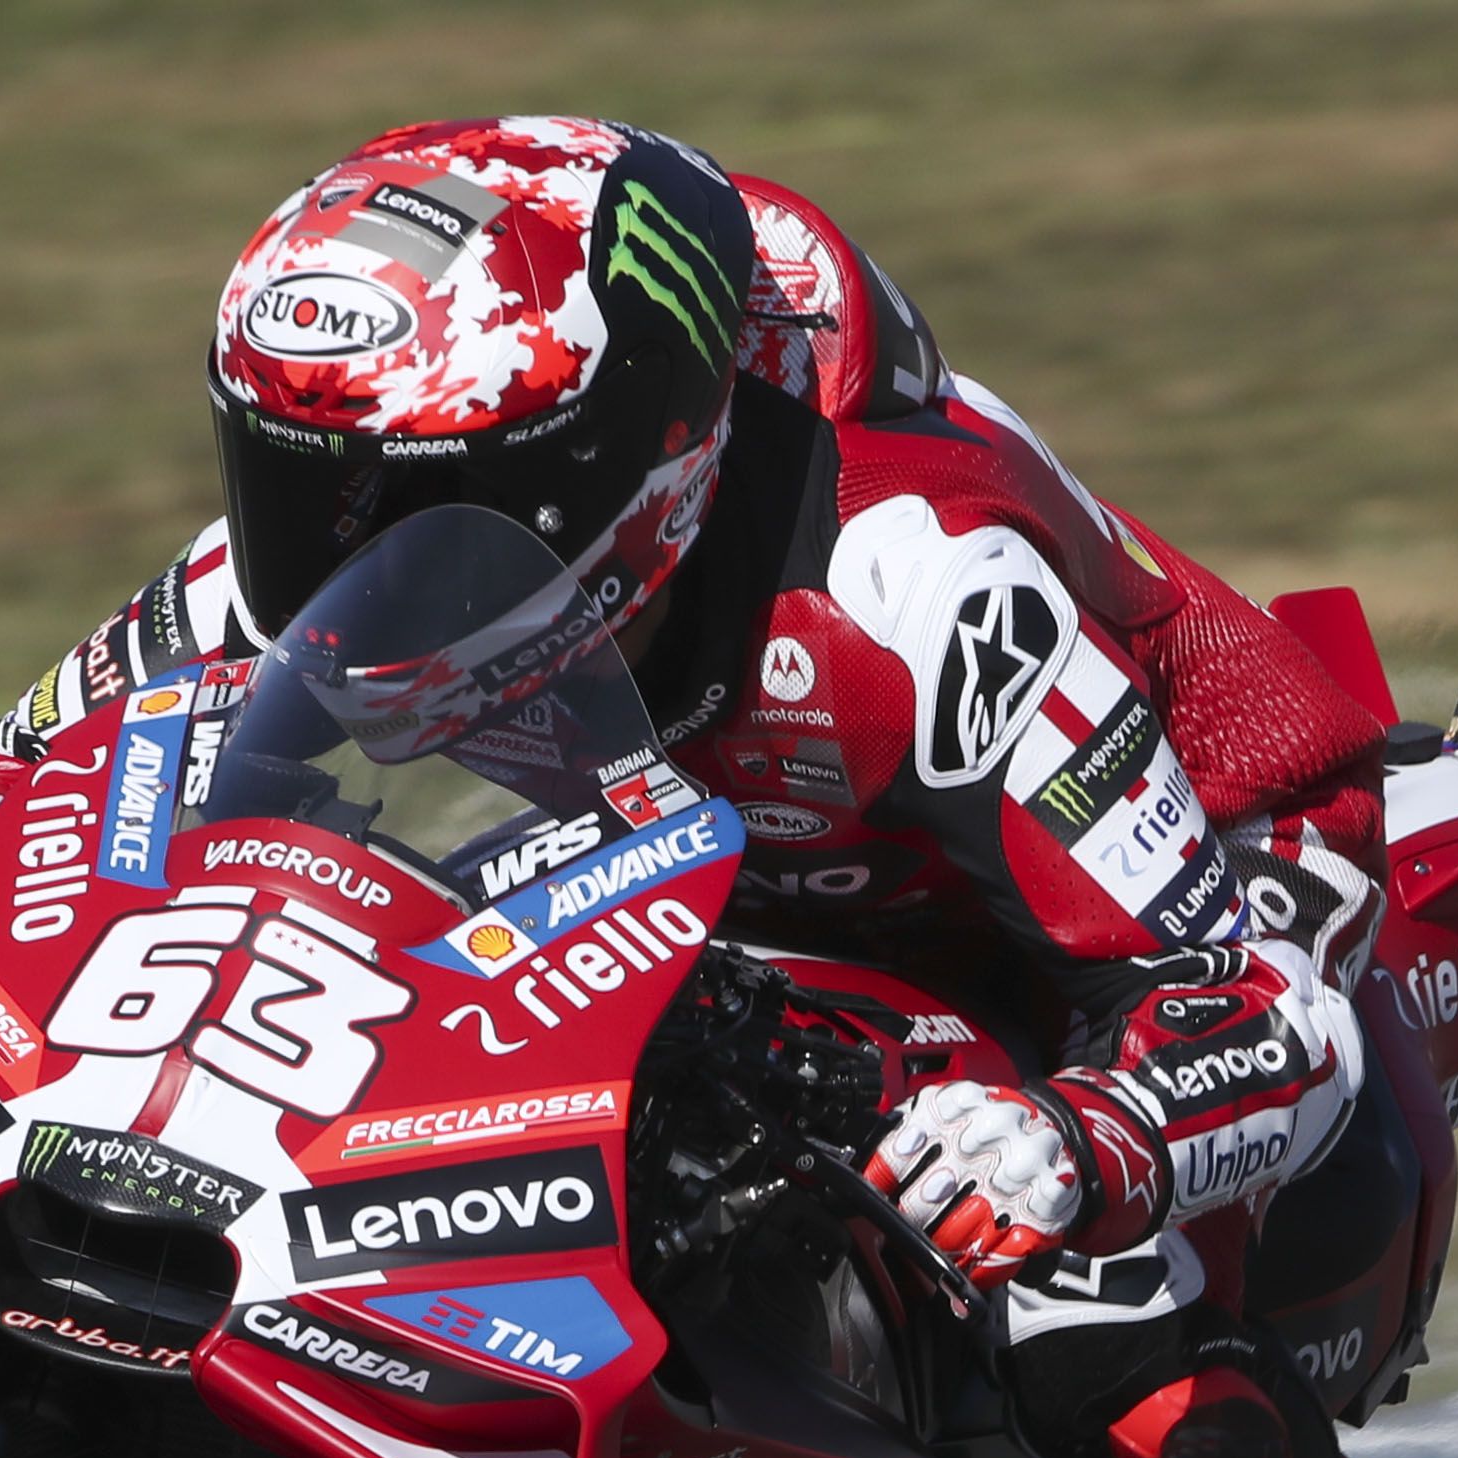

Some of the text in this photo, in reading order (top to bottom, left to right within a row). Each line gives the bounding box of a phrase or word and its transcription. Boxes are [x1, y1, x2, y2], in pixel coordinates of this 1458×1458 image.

[374, 186, 462, 235] Lenovo
[255, 287, 391, 347] SUOMY
[259, 419, 325, 448] MONSTER
[382, 437, 468, 456] CARRERA
[163, 565, 183, 655] MONSTER
[490, 576, 622, 681] Lenovo
[750, 707, 834, 728] motorola
[1076, 702, 1149, 783] MONSTER
[182, 719, 226, 808] WRS
[597, 746, 656, 786] BAGNAIA
[644, 780, 681, 801] Lenovo
[781, 757, 840, 781] Lenovo
[109, 733, 166, 874] ADVANCE
[10, 792, 98, 943] riello
[202, 838, 393, 910] VARGROUP
[478, 811, 603, 900] WRS
[547, 820, 719, 930] ADVANCE
[513, 897, 708, 1030] riello
[44, 907, 416, 1119] 63
[345, 1089, 616, 1147] FRECCIAROSSA
[66, 1134, 245, 1215] MONSTER
[80, 1168, 206, 1218] ENERGY
[303, 1176, 595, 1259] Lenovo
[0, 1308, 193, 1369] aruba.it
[242, 1303, 431, 1394] CARRERA
[484, 1316, 583, 1377] TIM
